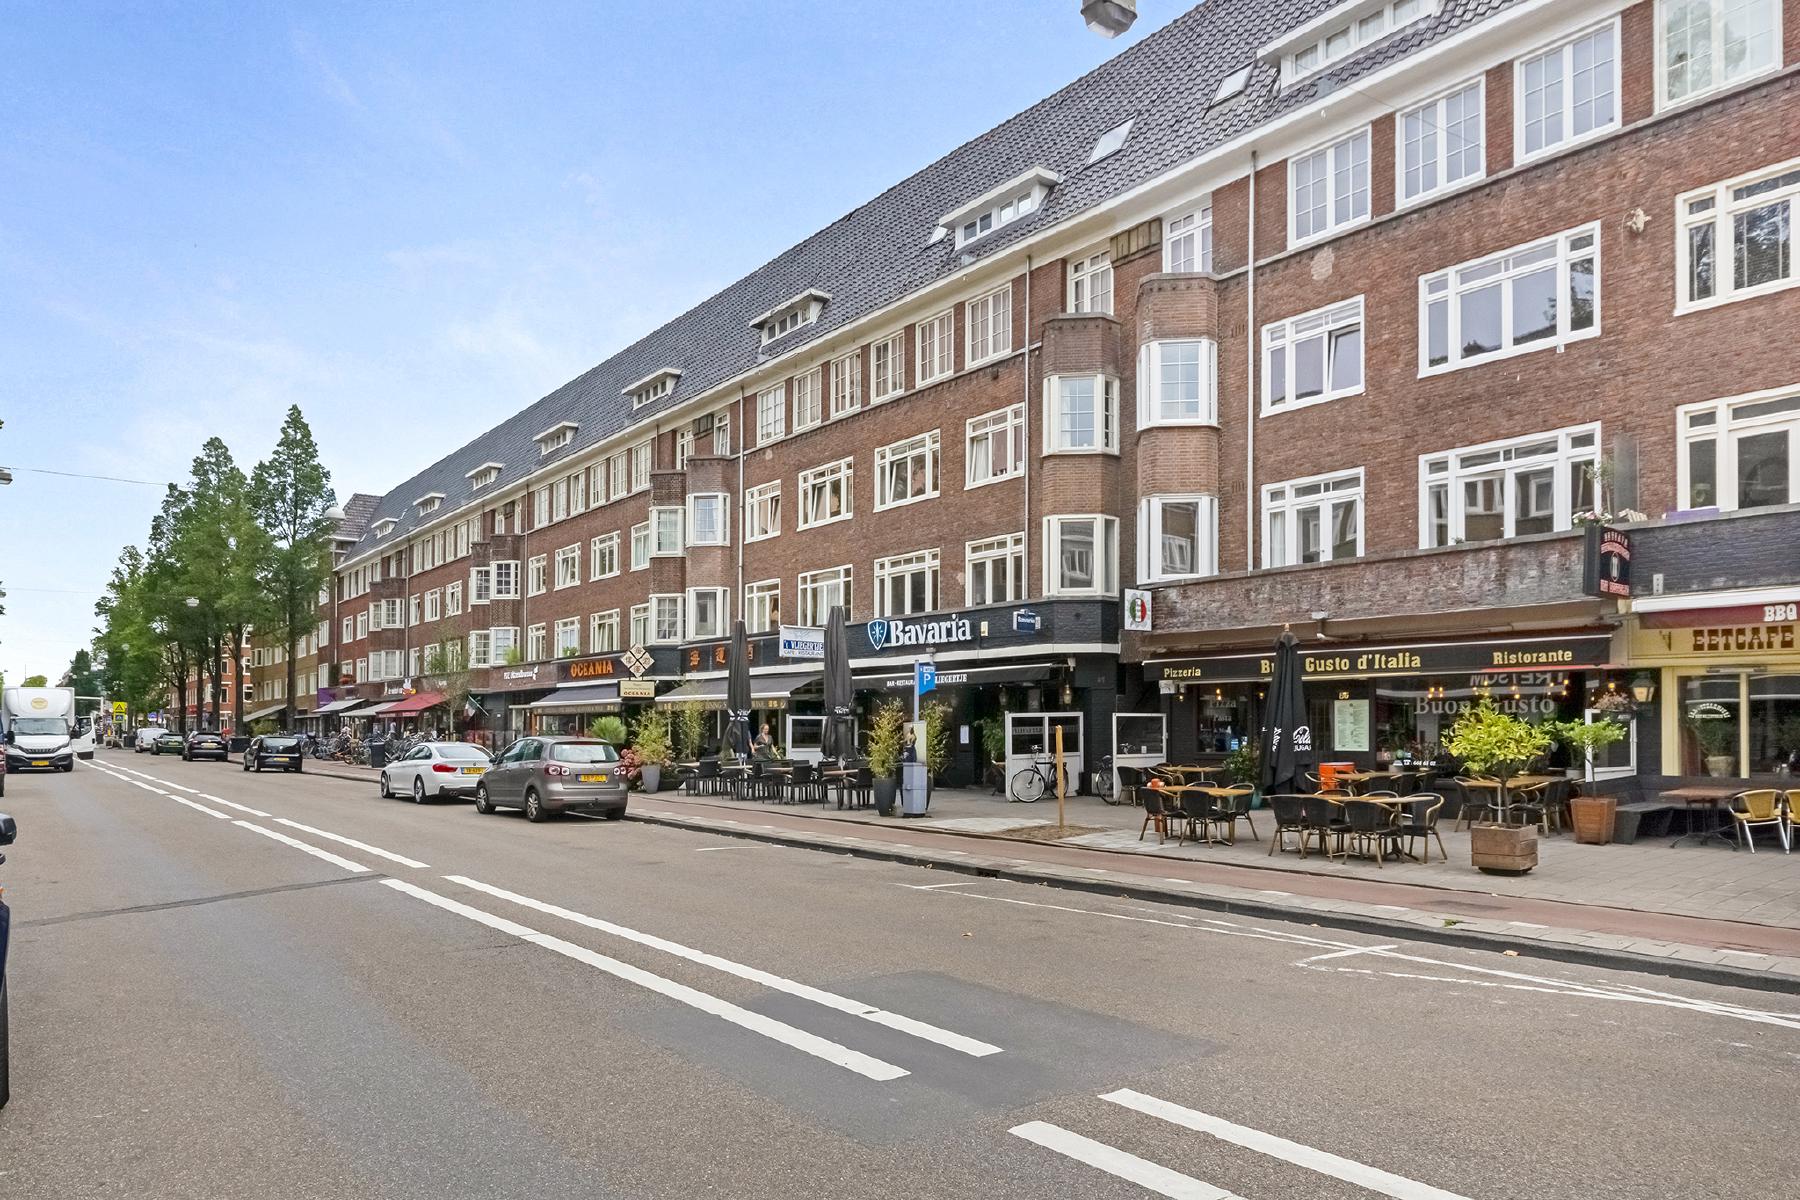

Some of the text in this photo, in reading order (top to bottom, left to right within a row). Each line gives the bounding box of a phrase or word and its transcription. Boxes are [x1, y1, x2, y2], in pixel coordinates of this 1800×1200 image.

[1763, 603, 1798, 622] BBQ
[889, 613, 972, 647] Bavaria
[1693, 625, 1794, 652] EETCAFE
[1305, 656, 1350, 672] Gusto
[1357, 652, 1421, 670] d'Italia
[1492, 649, 1573, 665] Ristorante
[570, 660, 614, 677] OCEANIA
[1163, 666, 1201, 678] Pizzeria
[923, 673, 931, 686] P
[935, 674, 968, 684] LIEGERTJE
